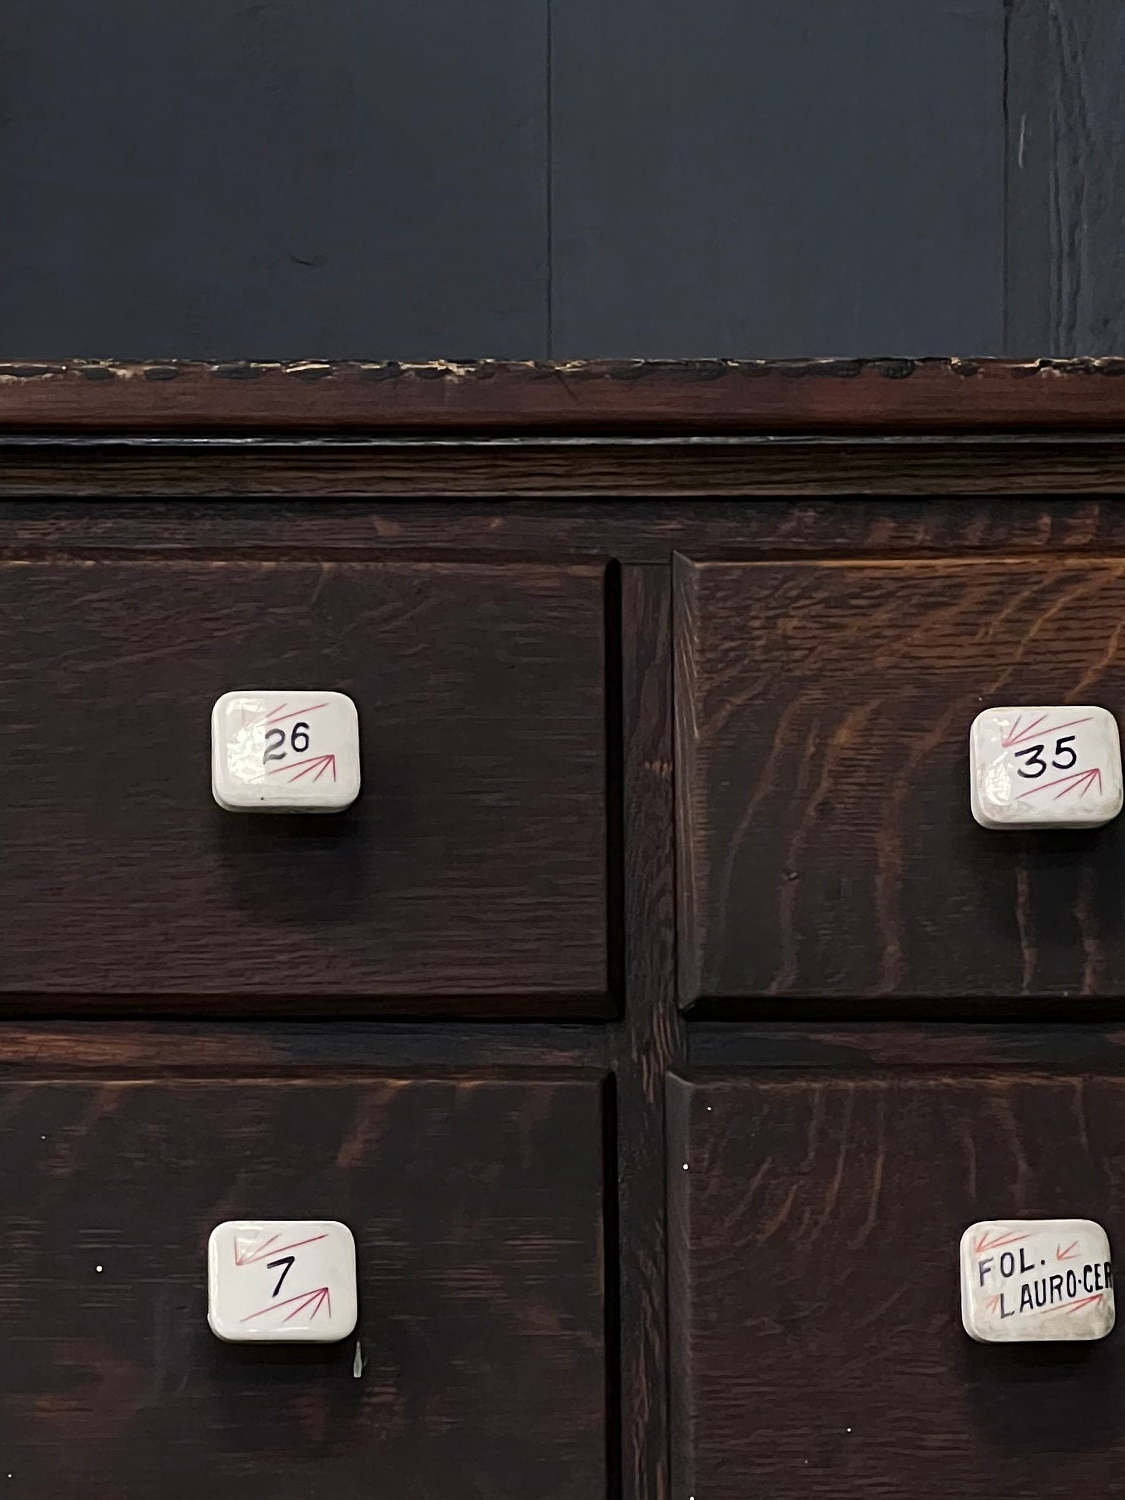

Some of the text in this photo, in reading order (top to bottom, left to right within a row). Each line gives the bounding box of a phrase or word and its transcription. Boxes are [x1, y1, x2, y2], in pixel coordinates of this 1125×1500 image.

[262, 722, 310, 765] 26
[1014, 736, 1078, 778] 35
[266, 1256, 295, 1298] 7
[978, 1248, 1046, 1287] FOL.
